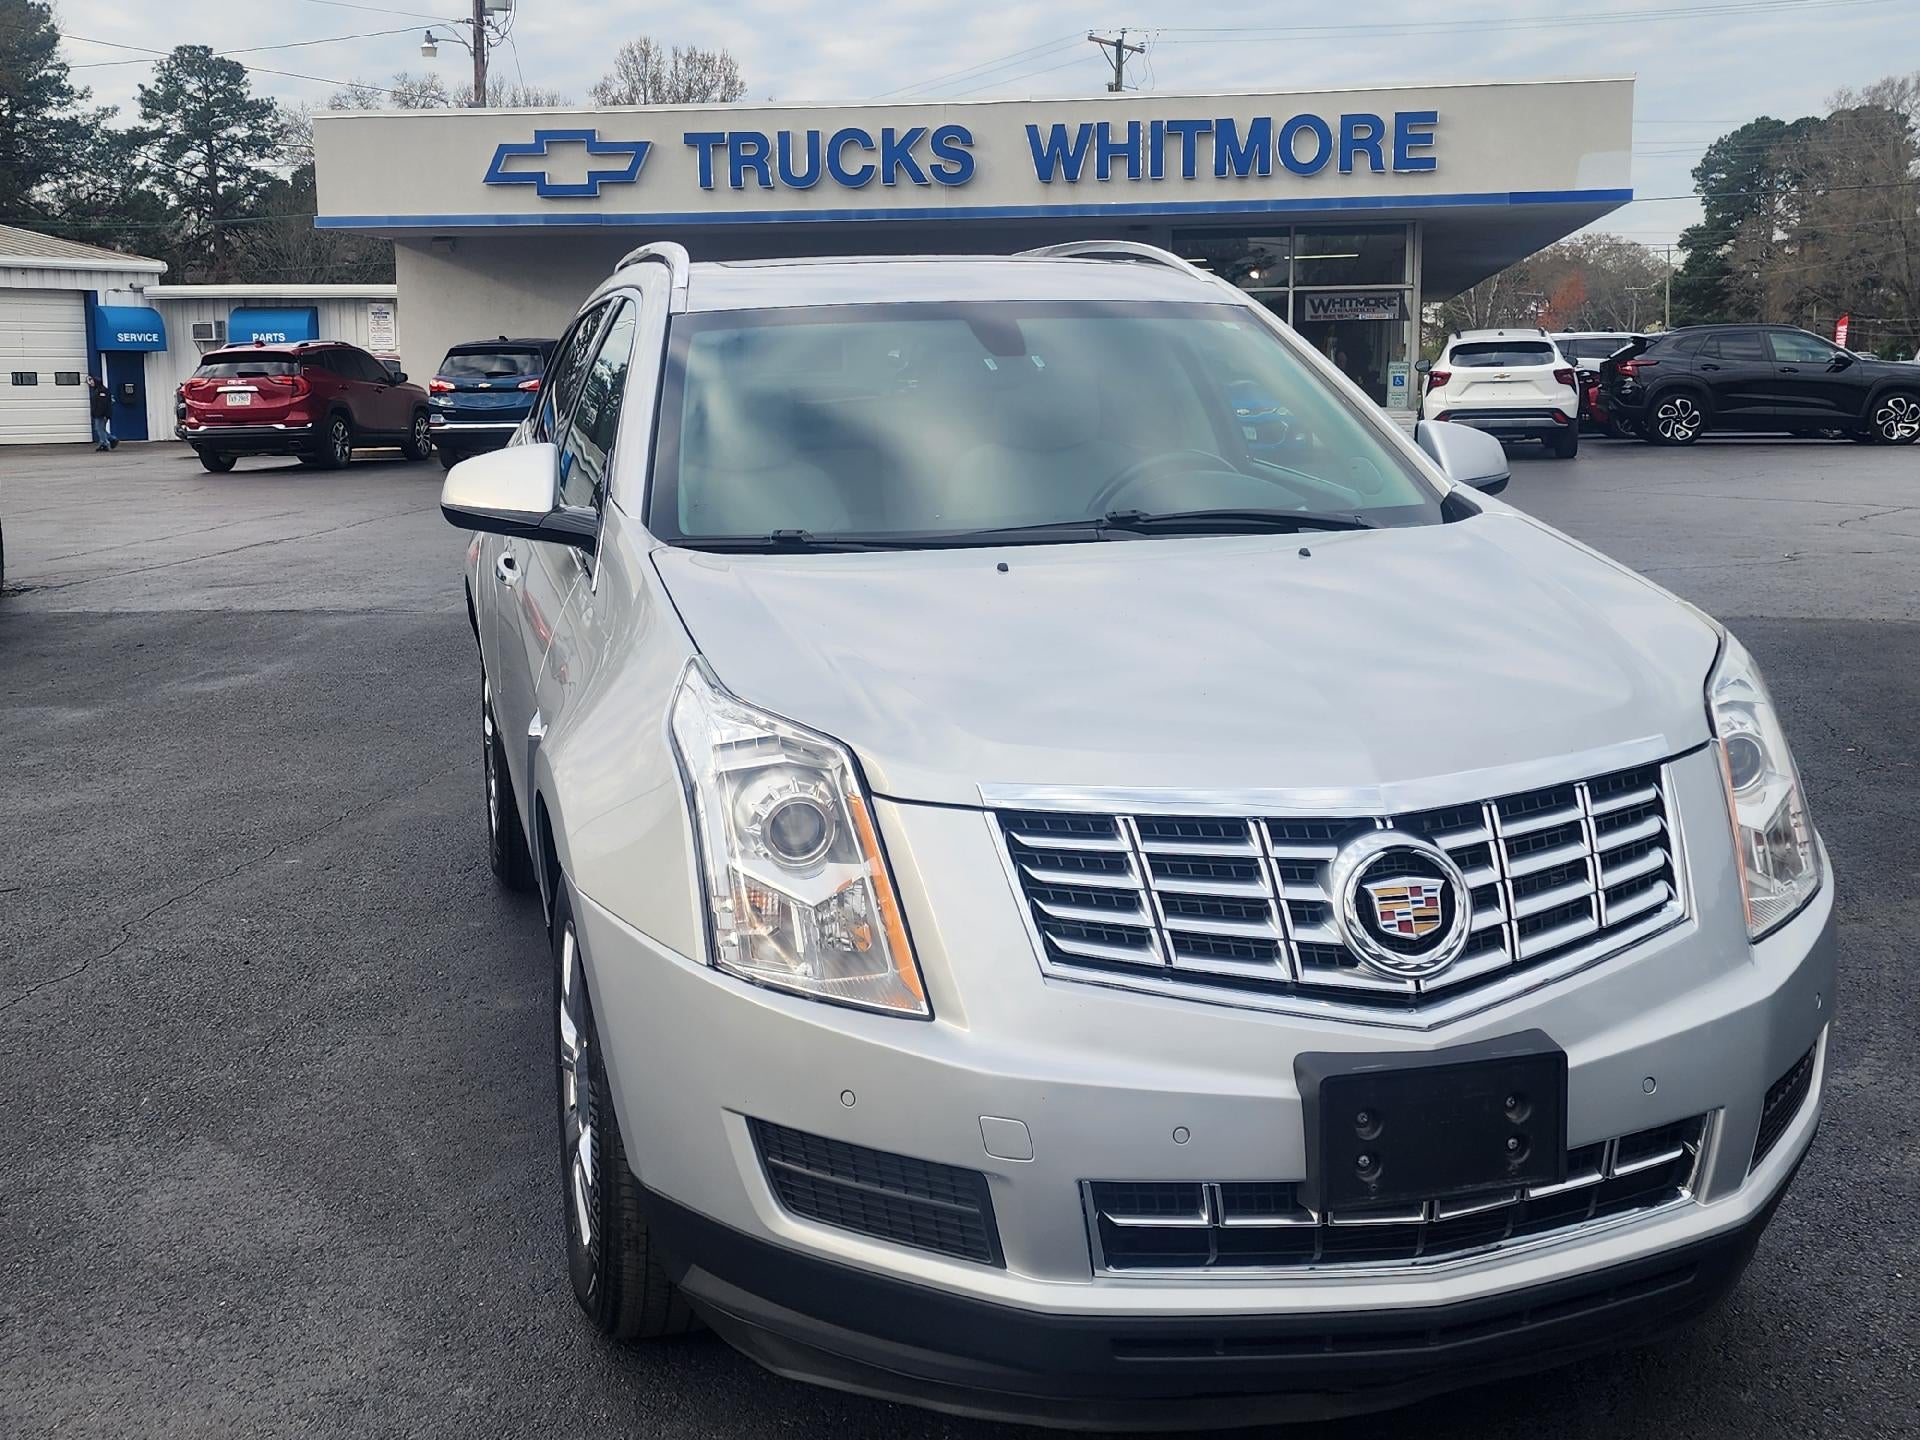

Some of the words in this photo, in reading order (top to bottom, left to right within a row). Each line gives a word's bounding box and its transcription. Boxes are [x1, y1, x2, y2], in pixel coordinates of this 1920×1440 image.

[684, 124, 976, 190] TRUCKS
[1025, 110, 1440, 184] WHITMORE
[1307, 296, 1399, 314] WHITMORE
[116, 332, 160, 342] SERVICE
[252, 332, 286, 342] PARTS
